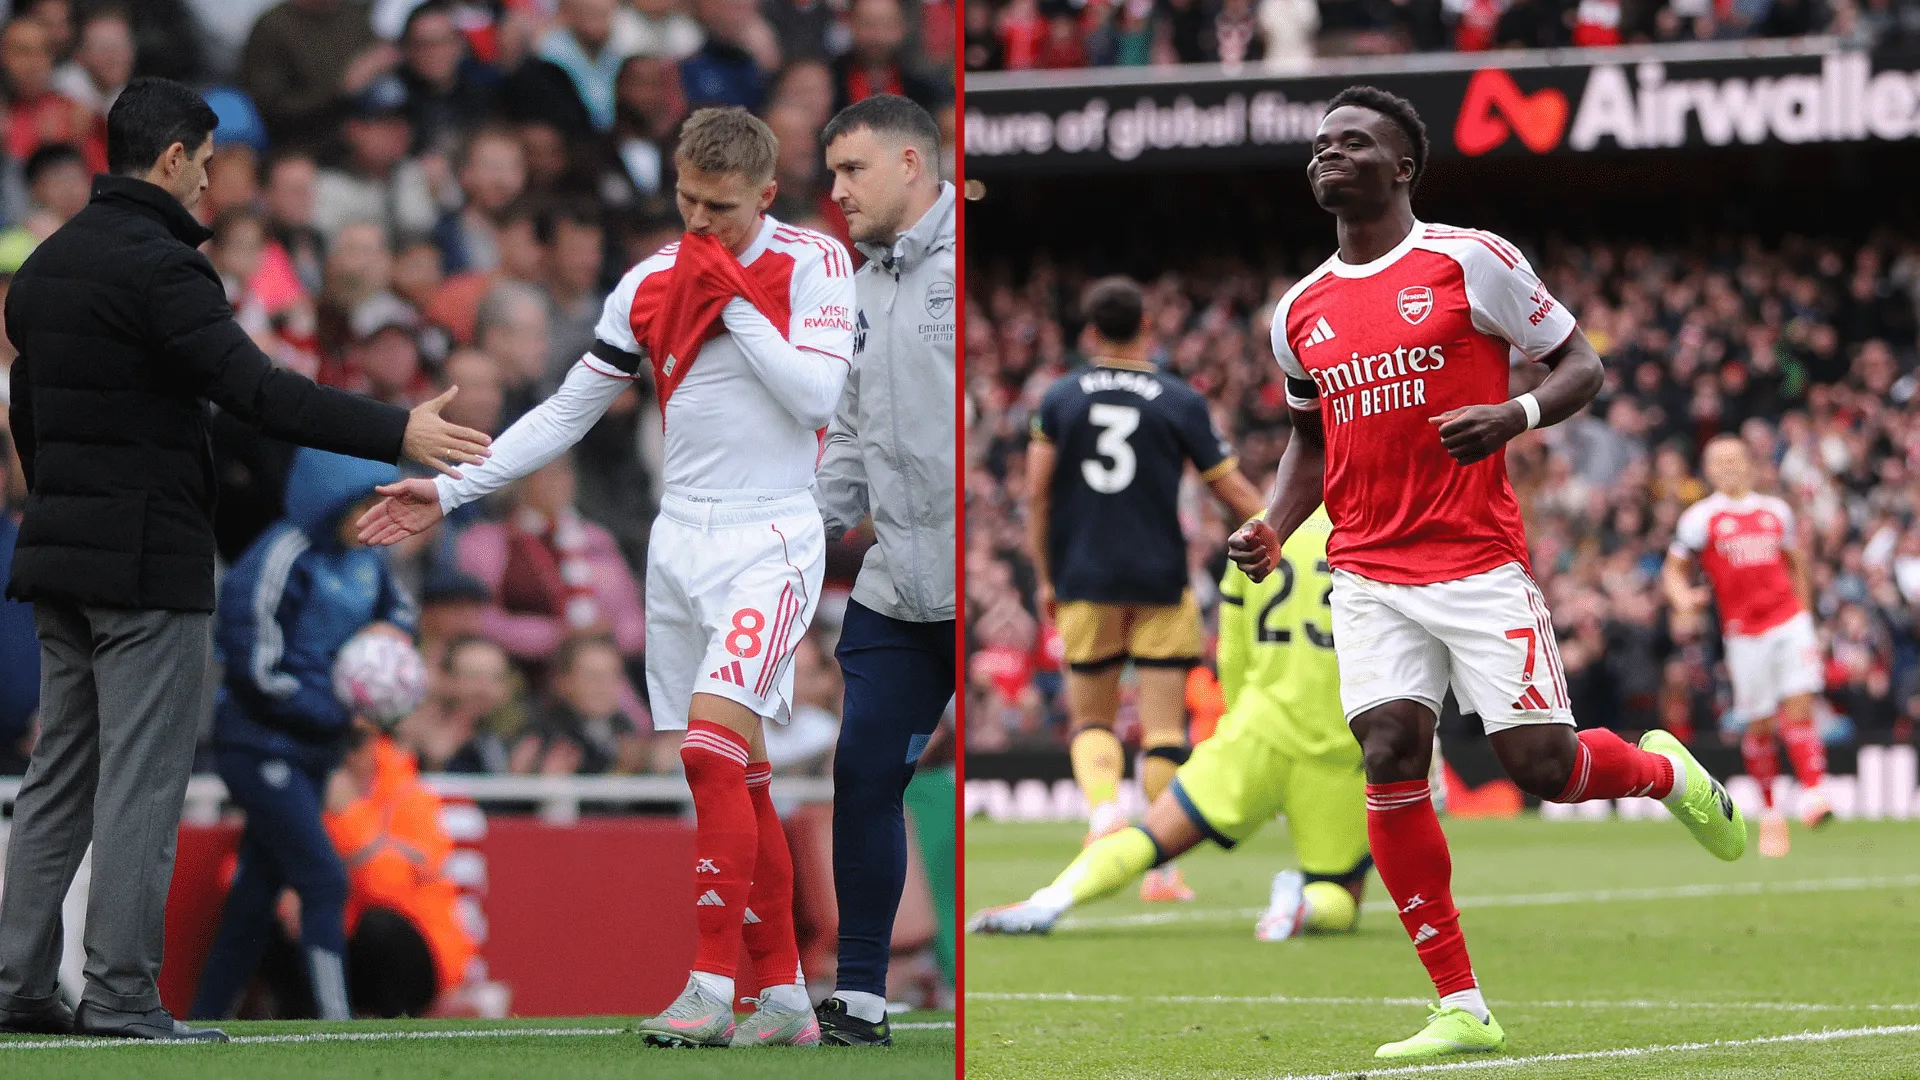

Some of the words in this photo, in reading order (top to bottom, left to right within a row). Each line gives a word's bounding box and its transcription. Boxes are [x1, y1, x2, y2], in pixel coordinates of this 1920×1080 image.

[1055, 98, 1107, 153] of
[1108, 92, 1246, 161] global
[1569, 53, 1920, 151] Airwalle
[820, 305, 849, 319] VISIT
[1402, 292, 1428, 300] Arsenal
[1309, 344, 1445, 398] Emirates
[1332, 393, 1355, 426] FLY
[1360, 378, 1426, 417] BETTER
[1081, 402, 1141, 494] 3
[724, 607, 766, 659] 8
[1504, 627, 1536, 682] 7
